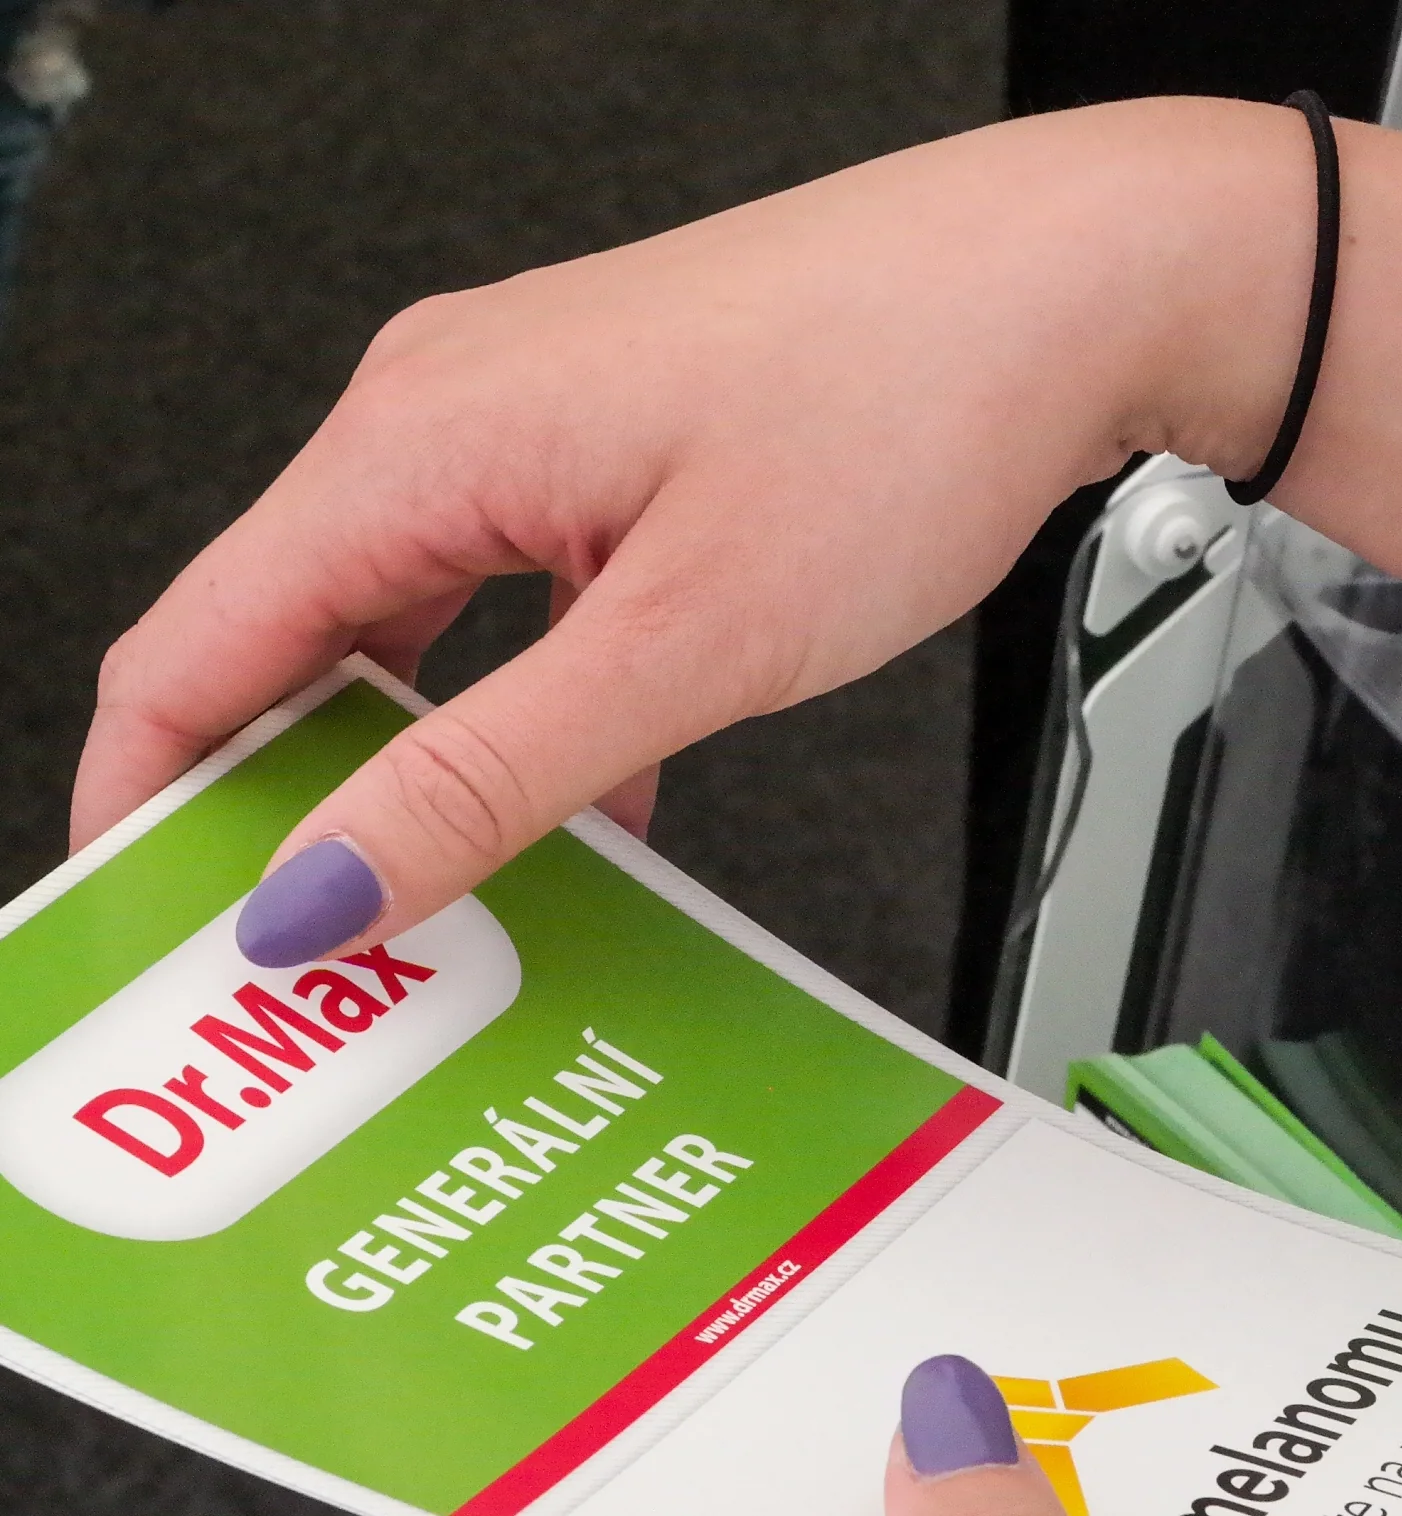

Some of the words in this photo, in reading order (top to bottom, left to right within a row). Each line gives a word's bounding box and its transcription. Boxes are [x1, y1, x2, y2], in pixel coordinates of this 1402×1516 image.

[72, 943, 438, 1179] Dr.Max
[305, 1027, 664, 1313] GENERÁLNÍ
[454, 1133, 754, 1350] PARTNER
[694, 1259, 802, 1344] www.drmax.cz
